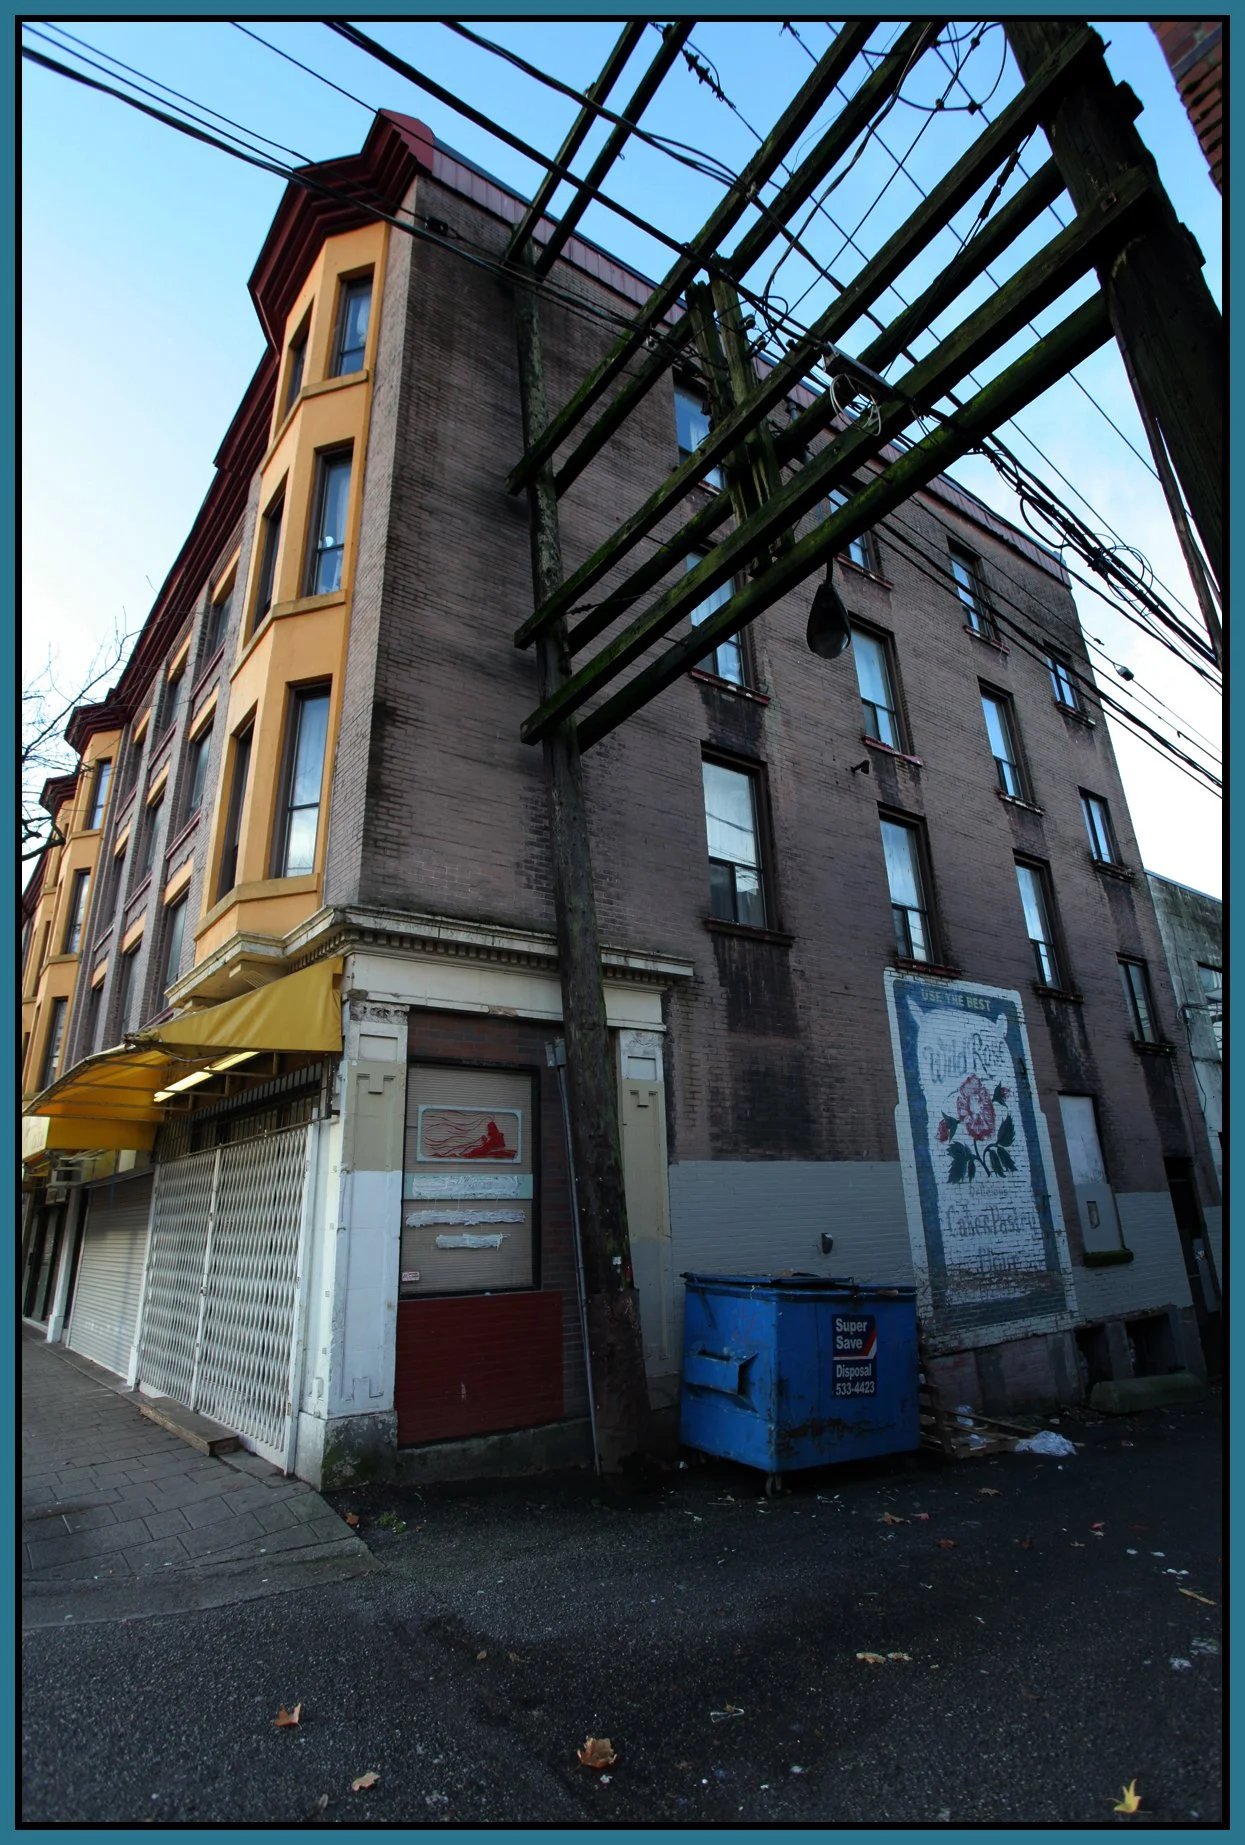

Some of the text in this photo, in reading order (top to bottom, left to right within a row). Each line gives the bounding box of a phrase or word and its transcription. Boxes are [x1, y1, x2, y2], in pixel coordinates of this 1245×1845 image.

[920, 988, 992, 1012] USE THE BEST
[922, 1032, 1006, 1084] Wild Rose
[835, 1318, 868, 1336] Super
[835, 1336, 863, 1350] Save
[836, 1362, 872, 1380] Disposal
[835, 1381, 875, 1396] 533-4423
